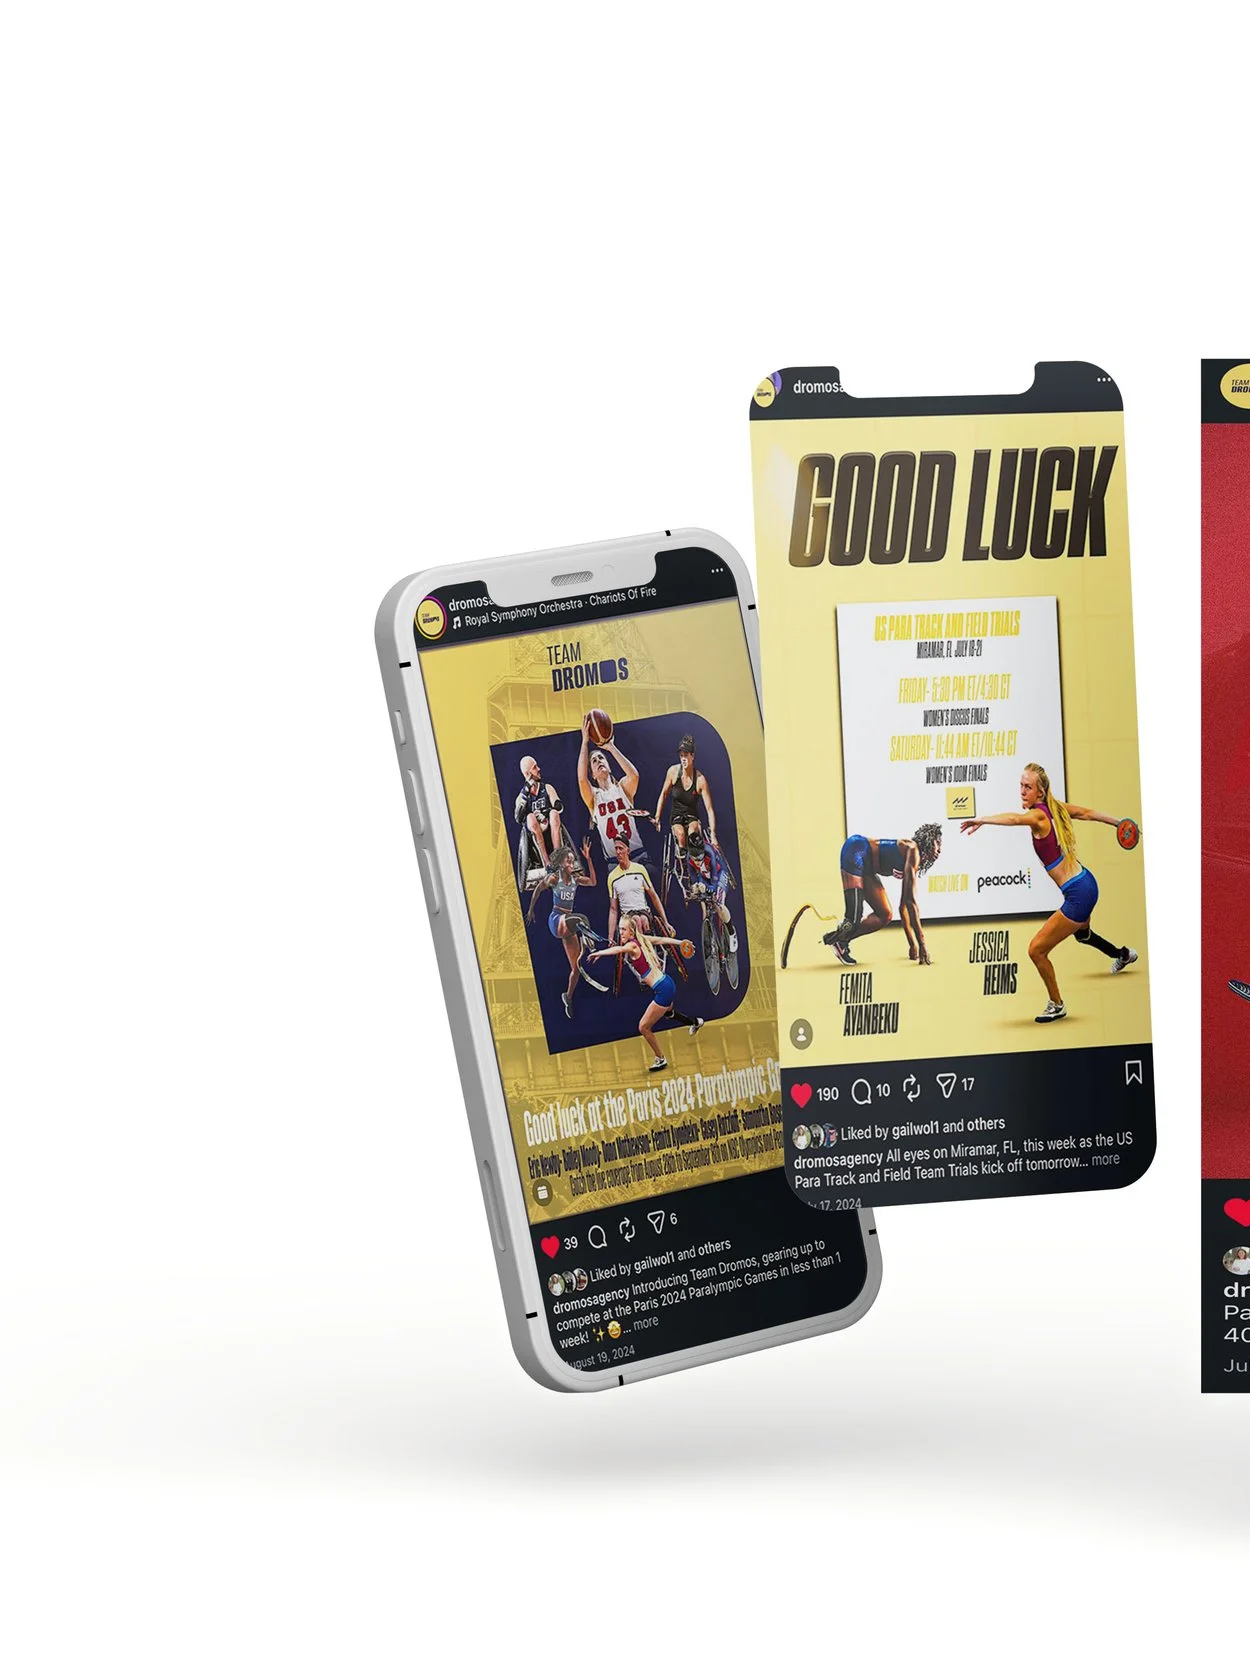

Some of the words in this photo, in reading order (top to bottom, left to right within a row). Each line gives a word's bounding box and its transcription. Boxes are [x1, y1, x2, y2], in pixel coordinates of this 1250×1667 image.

[789, 451, 956, 567] GOOD
[962, 446, 1118, 561] LUCK
[465, 611, 490, 627] Royal
[491, 606, 538, 623] Symphony
[539, 598, 583, 615] Orchestra
[589, 591, 627, 606] Chariots
[628, 588, 640, 600] Of
[641, 586, 657, 598] Fire
[546, 641, 582, 666] TEAM
[598, 798, 627, 816] USA
[606, 813, 632, 839] 43
[978, 870, 1026, 892] peacock
[969, 930, 1010, 964] JESSICA
[839, 972, 873, 1005] FEMITA
[983, 962, 1018, 996] HEIMS
[843, 1002, 900, 1037] AYANBEKU
[817, 1087, 838, 1101] 190
[877, 1084, 890, 1096] 10
[962, 1078, 974, 1090] 17
[523, 1104, 558, 1148] Good
[557, 1097, 589, 1139] luck
[588, 1098, 604, 1133] at
[603, 1091, 627, 1129] the
[626, 1082, 662, 1124] Paris
[662, 1075, 696, 1117] 2024
[695, 1058, 767, 1109] Paralympic
[794, 1153, 883, 1169] dromosagency
[887, 1148, 900, 1162] All
[904, 1150, 930, 1163] eyes
[933, 1148, 947, 1159] on
[951, 1144, 999, 1157] Miramar,
[1004, 1141, 1020, 1155] FL,
[1024, 1139, 1044, 1152] this
[1047, 1136, 1076, 1149] week
[1080, 1138, 1092, 1148] as
[1096, 1134, 1113, 1146] the
[1117, 1132, 1132, 1145] US
[795, 1176, 820, 1188] Para
[824, 1171, 856, 1186] Track
[859, 1169, 880, 1183] and
[884, 1167, 910, 1182] Field
[914, 1166, 944, 1179] Team
[948, 1163, 978, 1176] Trials
[982, 1161, 1004, 1174] kick
[1008, 1159, 1022, 1172] off
[1026, 1158, 1088, 1171] tomorrow...
[1093, 1155, 1119, 1165] more
[669, 1213, 678, 1225] 6
[564, 1236, 579, 1250] 39
[553, 1287, 630, 1314] dromosagency
[632, 1273, 688, 1295] Introducing
[690, 1266, 717, 1281] Team
[719, 1256, 760, 1274] Dromos,
[762, 1246, 798, 1266] gearing
[800, 1243, 813, 1255] up
[815, 1240, 825, 1251] to
[556, 1312, 600, 1331] compete
[603, 1308, 613, 1321] at
[615, 1304, 631, 1317] the
[634, 1297, 659, 1312] Paris
[661, 1289, 687, 1306] 2024
[689, 1276, 743, 1299] Paralympic
[744, 1268, 778, 1285] Games
[779, 1264, 789, 1276] in
[791, 1260, 811, 1274] less
[812, 1254, 834, 1269] than
[836, 1251, 841, 1263] 1
